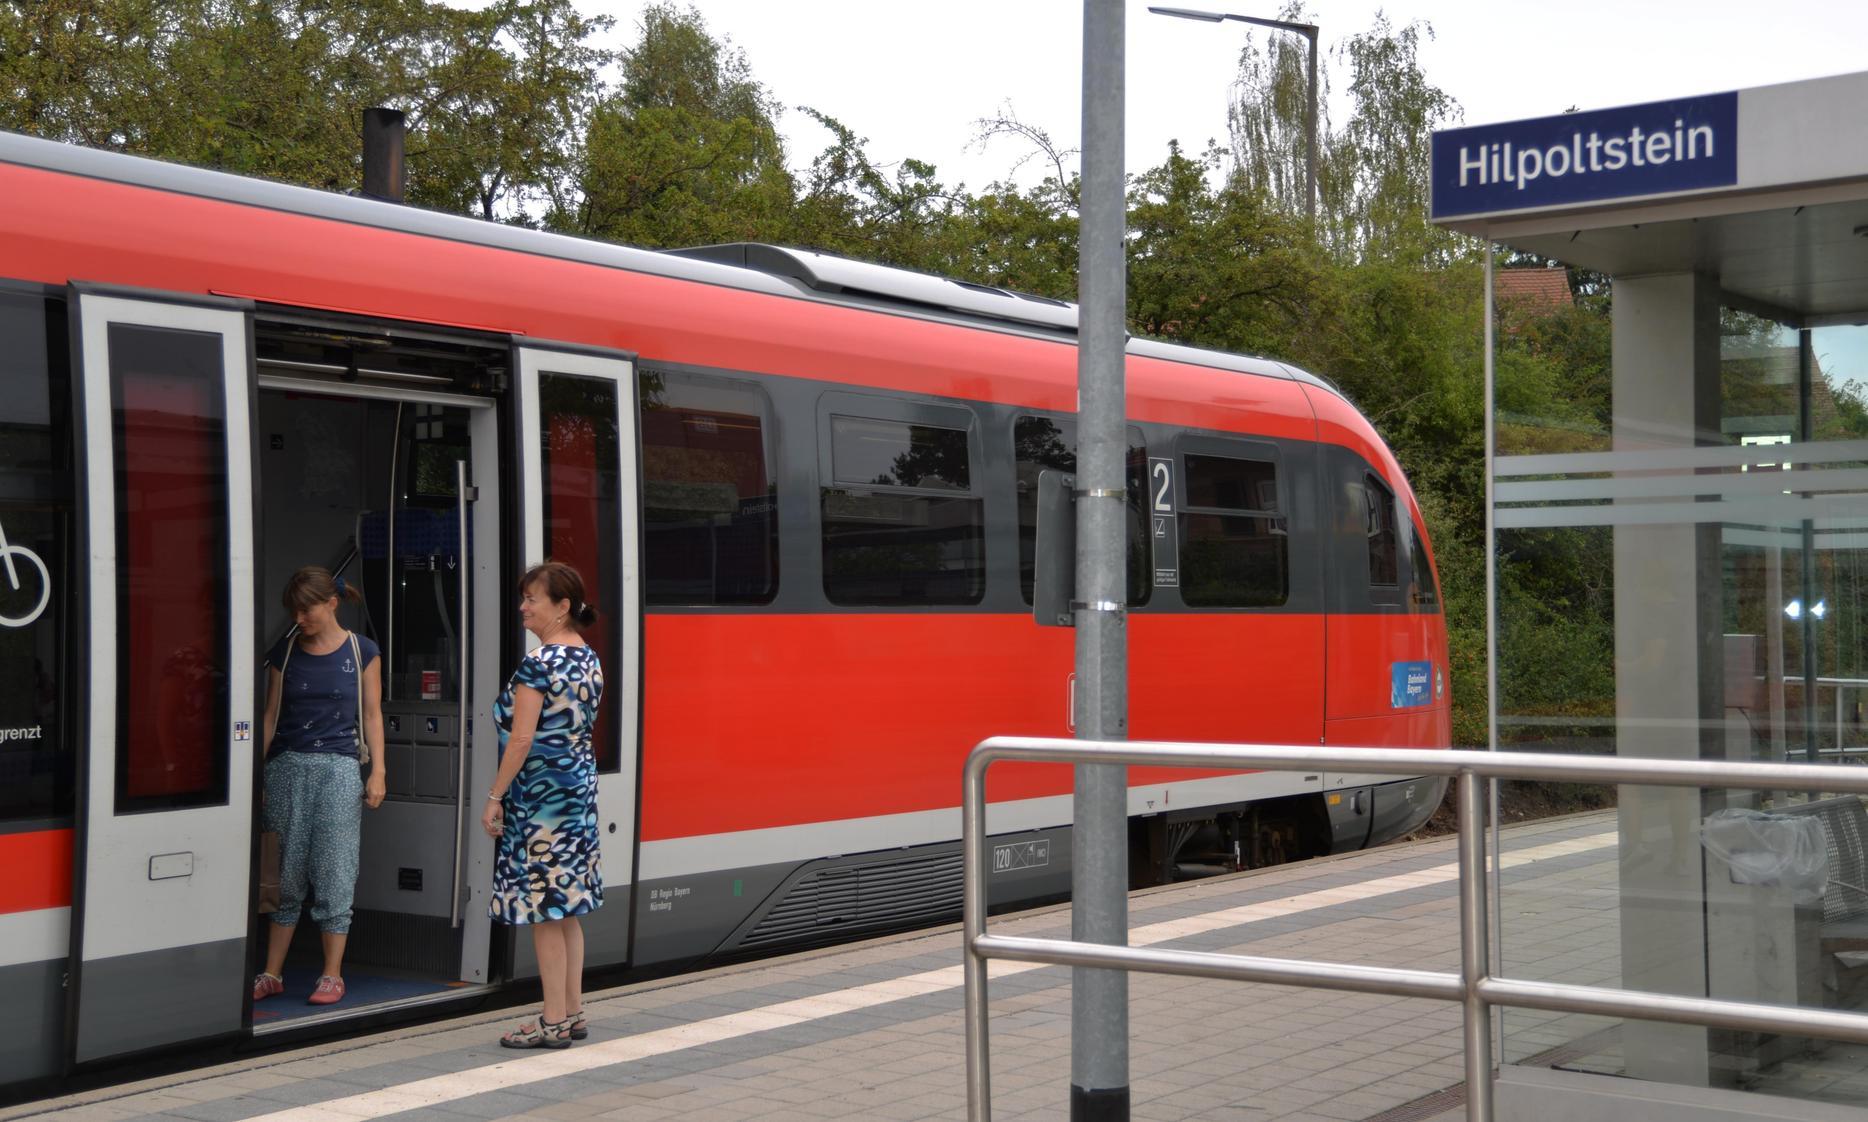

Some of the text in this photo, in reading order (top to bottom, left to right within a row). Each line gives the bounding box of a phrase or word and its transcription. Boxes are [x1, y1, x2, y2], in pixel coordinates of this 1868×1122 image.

[1459, 119, 1714, 190] Hilpoltstein
[1153, 462, 1170, 511] 2
[996, 848, 1010, 869] 120
[650, 887, 690, 900] DB Regio Bayern
[650, 900, 672, 912] Nürnberg
